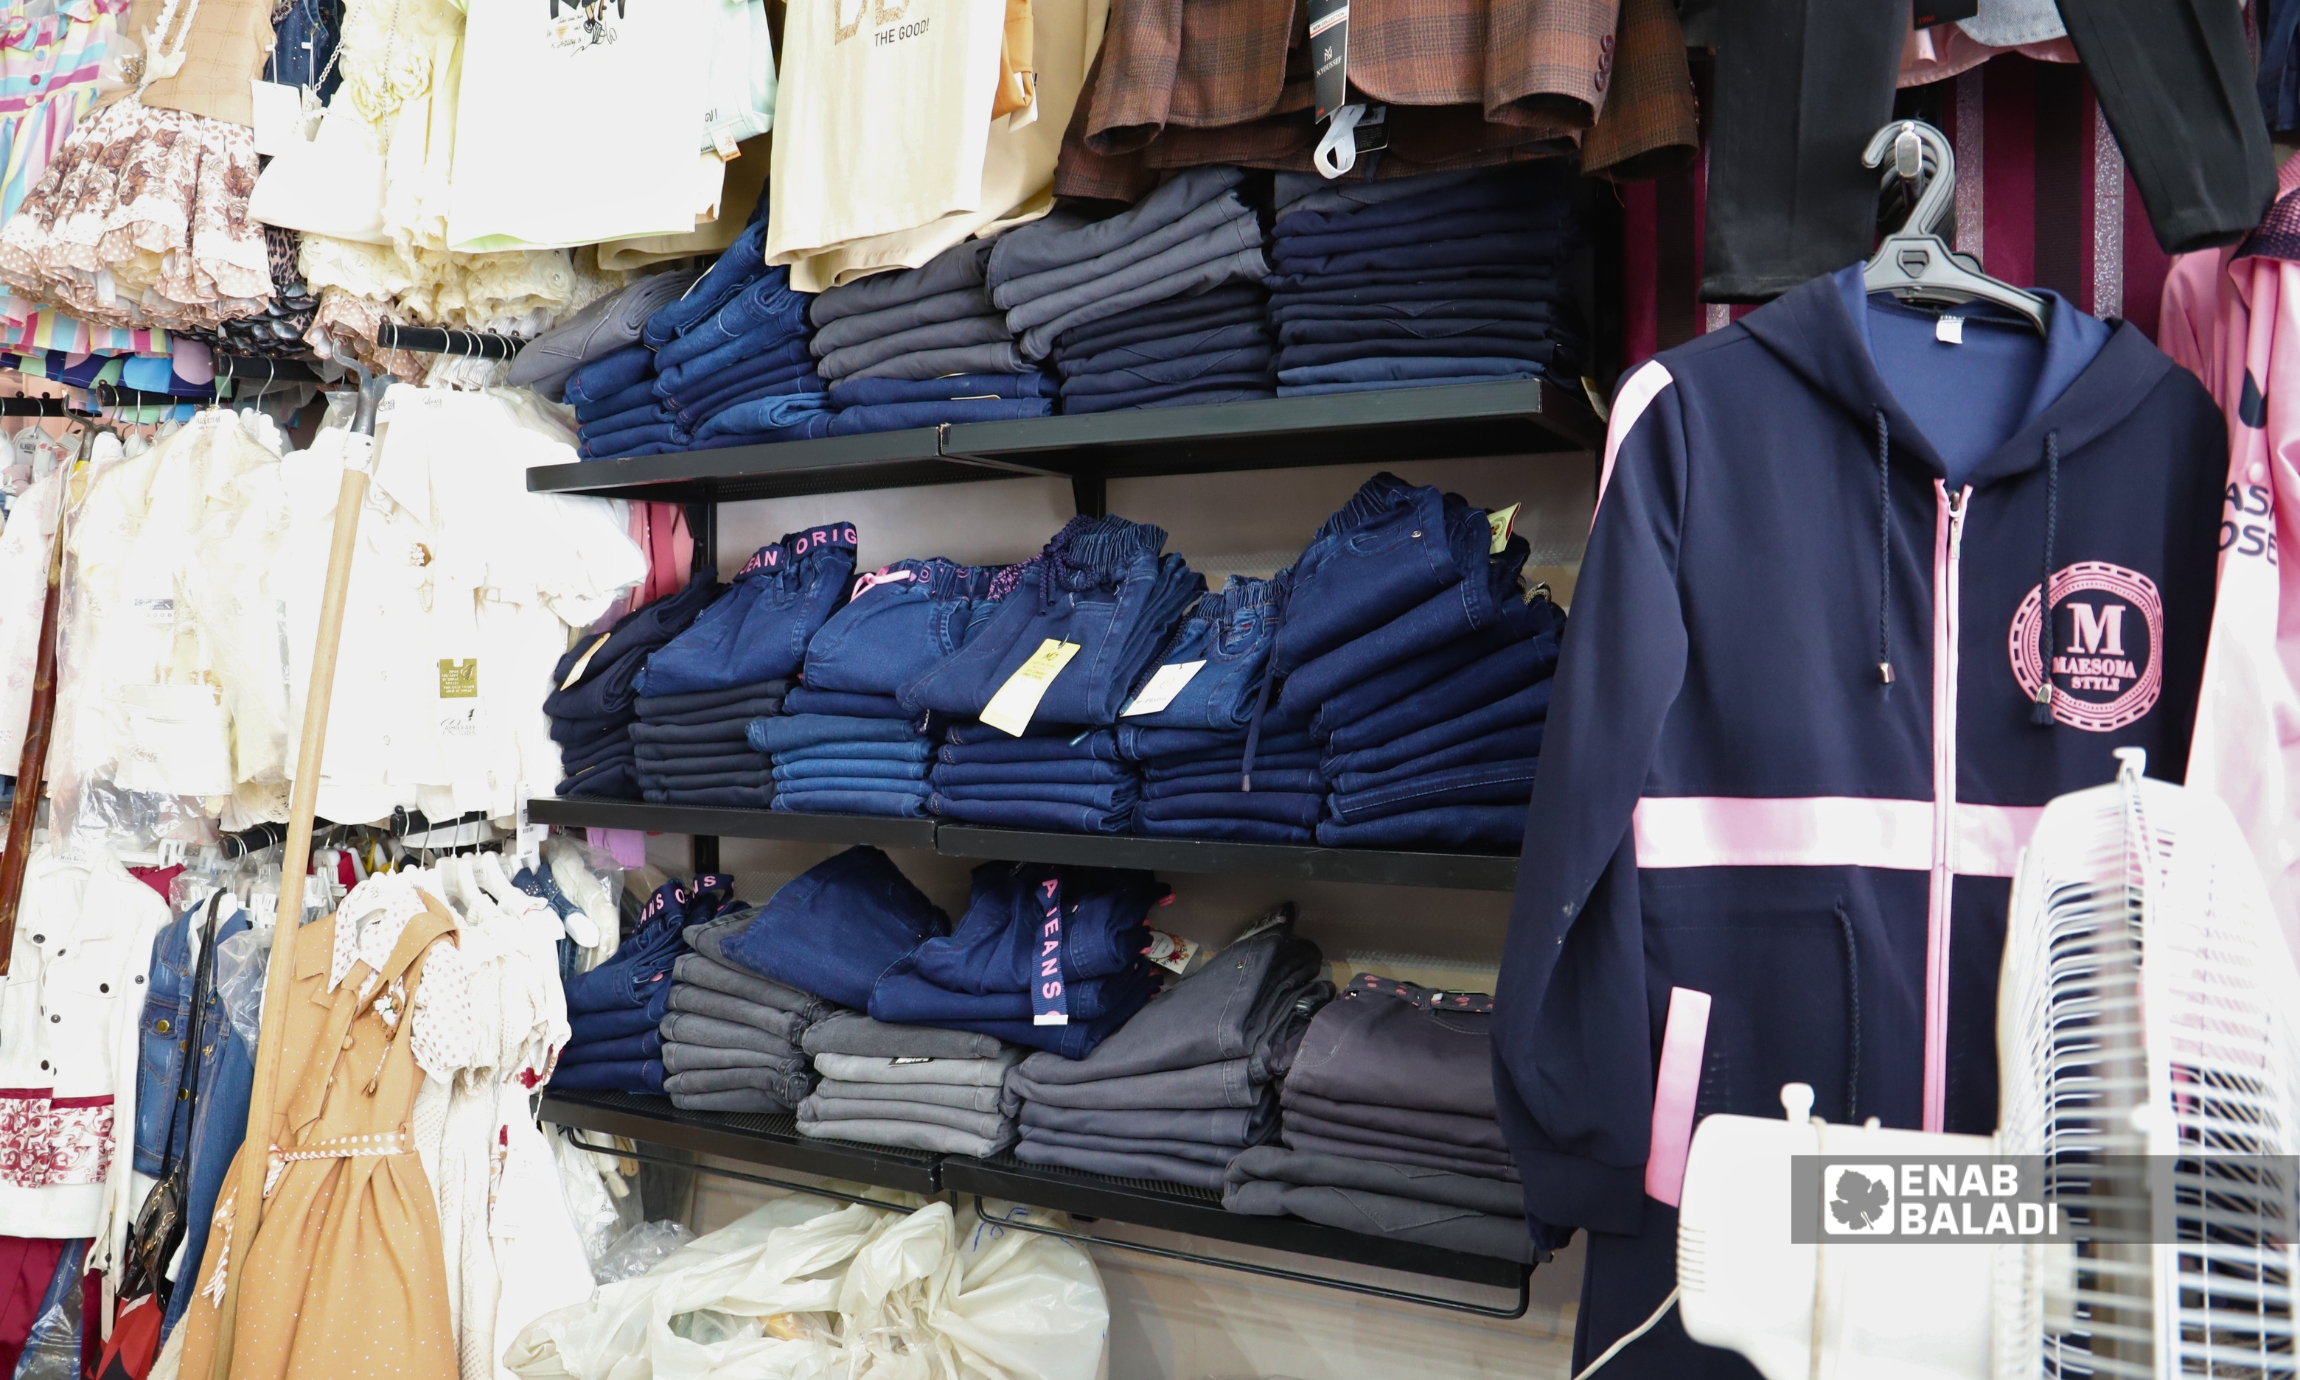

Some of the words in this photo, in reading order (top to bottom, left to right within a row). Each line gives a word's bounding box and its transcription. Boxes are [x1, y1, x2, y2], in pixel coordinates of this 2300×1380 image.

[1321, 12, 1345, 26] COLLECTION
[875, 29, 895, 47] THE
[898, 18, 930, 40] GOOD!
[2066, 602, 2126, 656] M
[2070, 675, 2120, 692] STYLE
